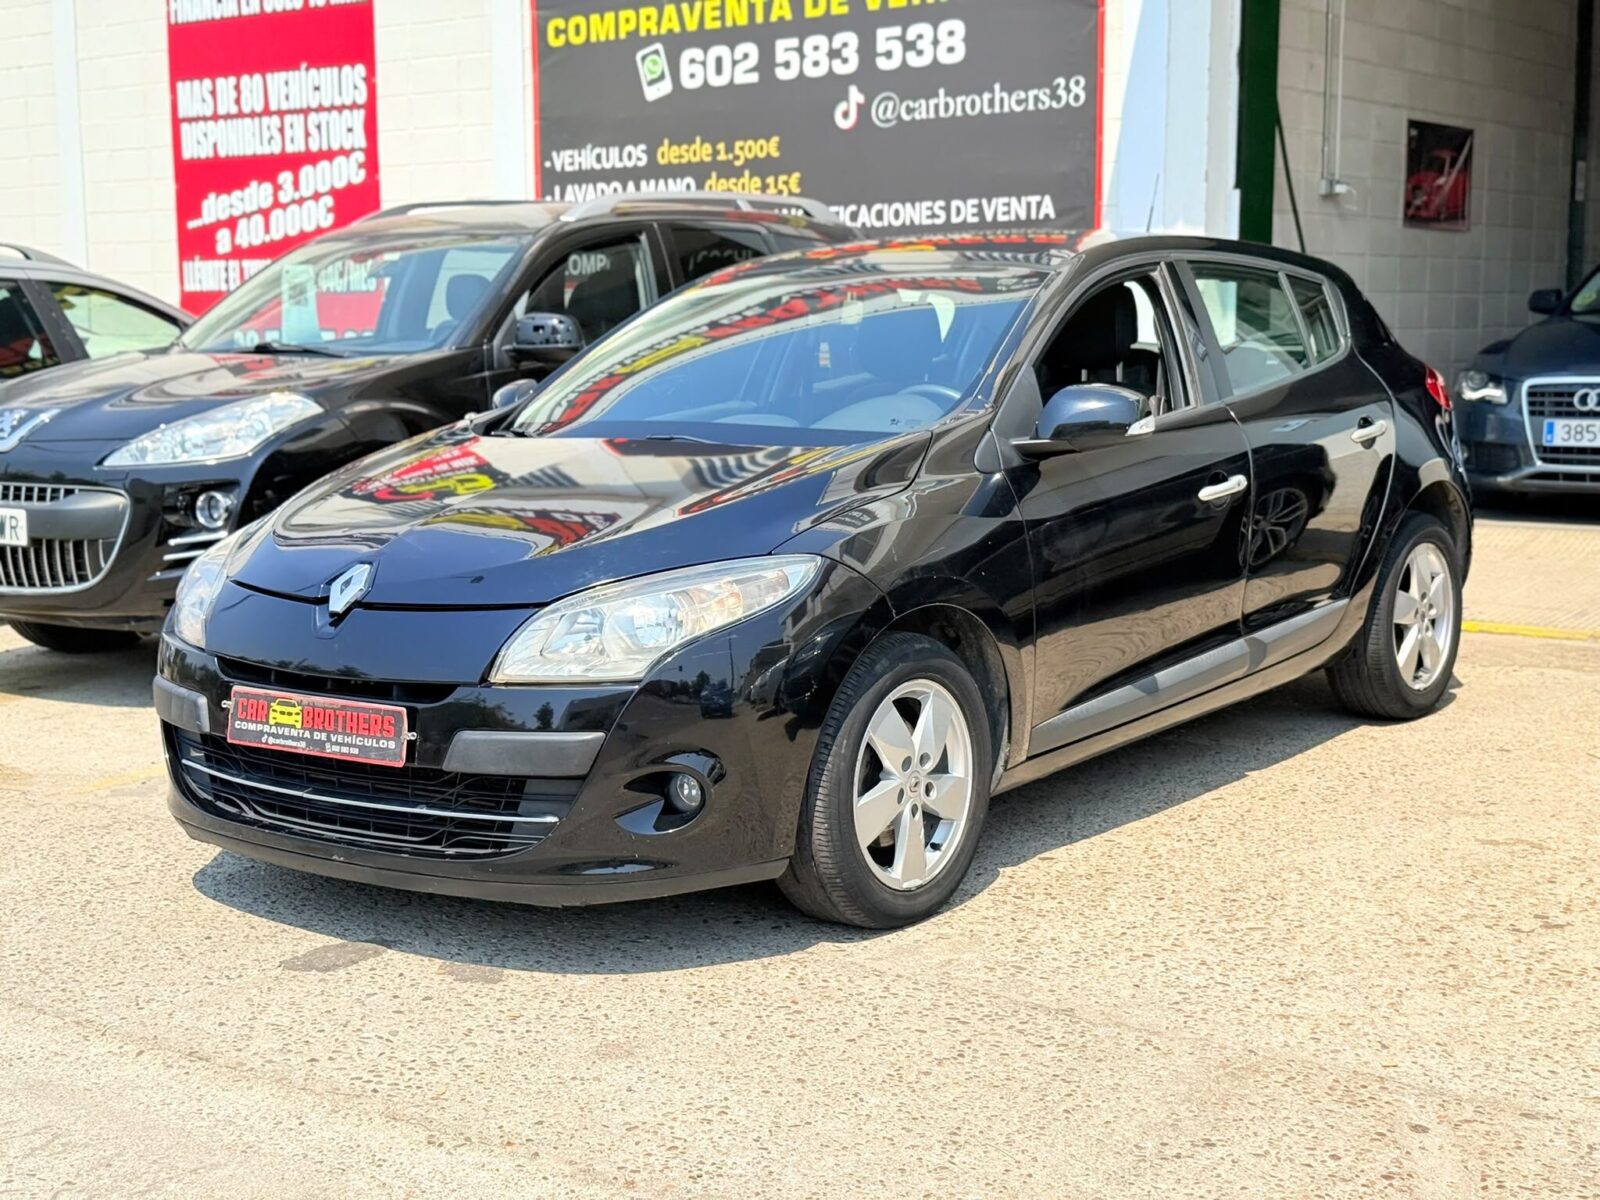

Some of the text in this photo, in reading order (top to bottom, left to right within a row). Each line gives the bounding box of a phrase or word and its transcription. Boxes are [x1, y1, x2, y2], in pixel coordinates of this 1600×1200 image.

[546, 0, 793, 48] COMPRAVENTA
[679, 19, 966, 90] 602 583 538
[215, 76, 238, 116] DE
[239, 73, 264, 113] 80
[265, 62, 367, 111] VEHÍCULOS
[871, 75, 1087, 128] @carbrothers38
[180, 108, 367, 160] DISPONIBLES EN STOCK
[551, 137, 780, 173] VEHÍCULOS desde 1.500€
[277, 151, 366, 204] 3.000€
[554, 181, 624, 201] LAVADO
[640, 176, 697, 192] MANO
[704, 170, 761, 194] desde
[766, 172, 801, 197] 15€
[215, 195, 335, 255] a 40.000€
[951, 200, 979, 223] DE
[982, 194, 1056, 222] VENTA
[234, 720, 311, 739] COMPRAVENTA
[314, 731, 328, 742] DE
[330, 732, 396, 750] VEHÍCULOS
[237, 697, 396, 738] CAR BROTHERS
